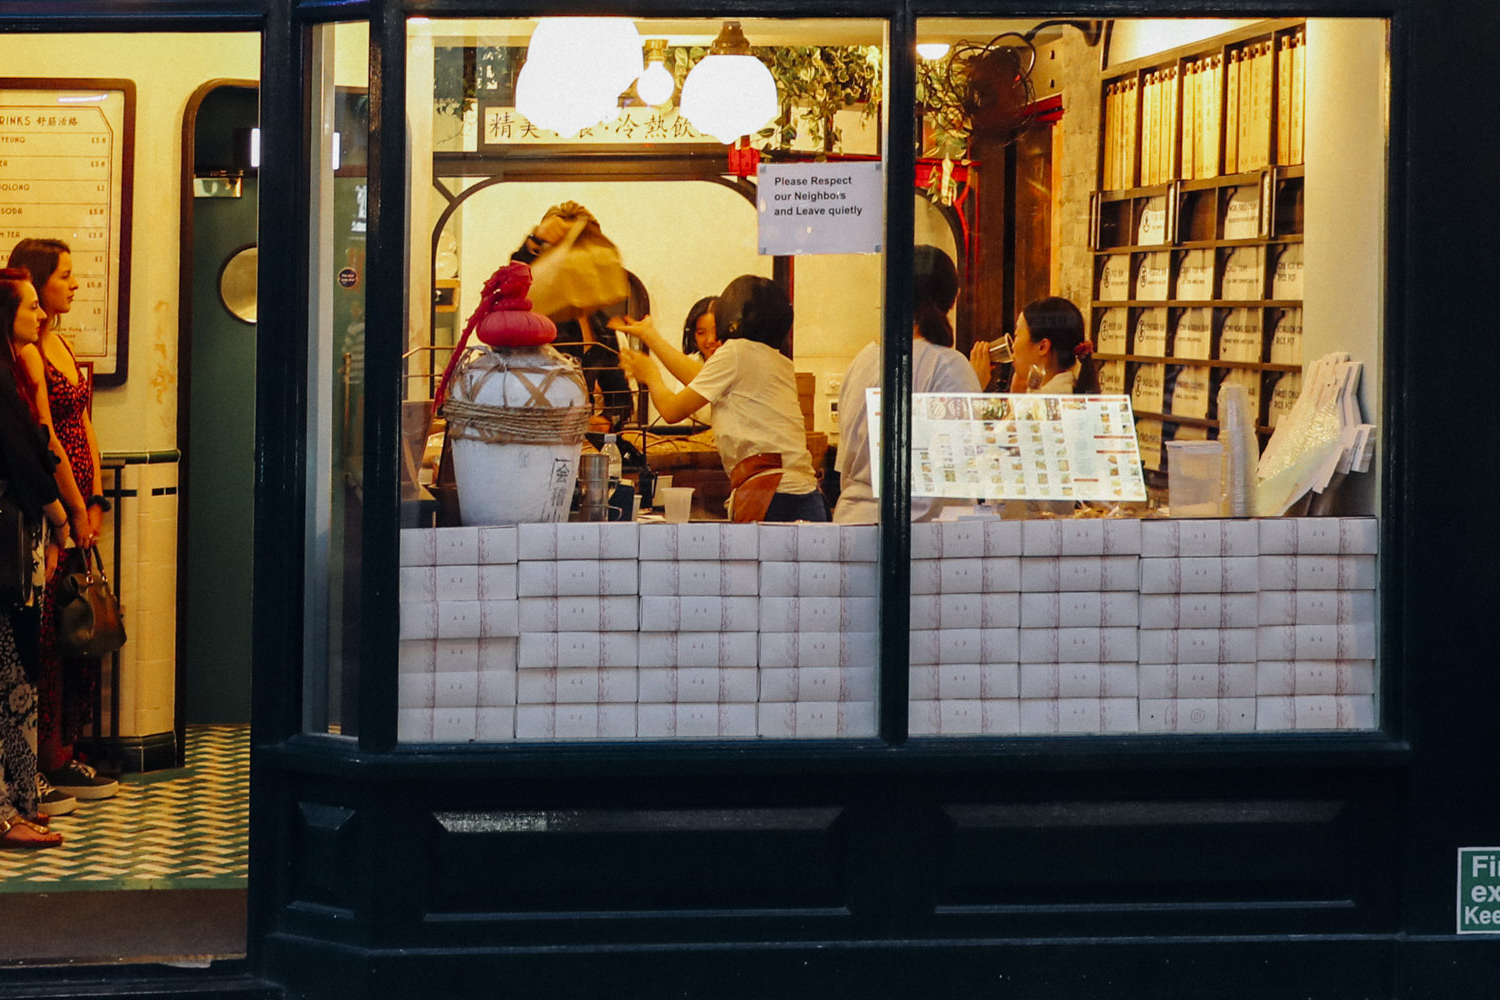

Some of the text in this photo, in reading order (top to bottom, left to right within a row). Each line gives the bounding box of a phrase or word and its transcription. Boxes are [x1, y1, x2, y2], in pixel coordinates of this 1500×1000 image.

[774, 176, 852, 187] Please Respect
[774, 206, 863, 217] and Leave quietly
[1472, 855, 1500, 877] Fi
